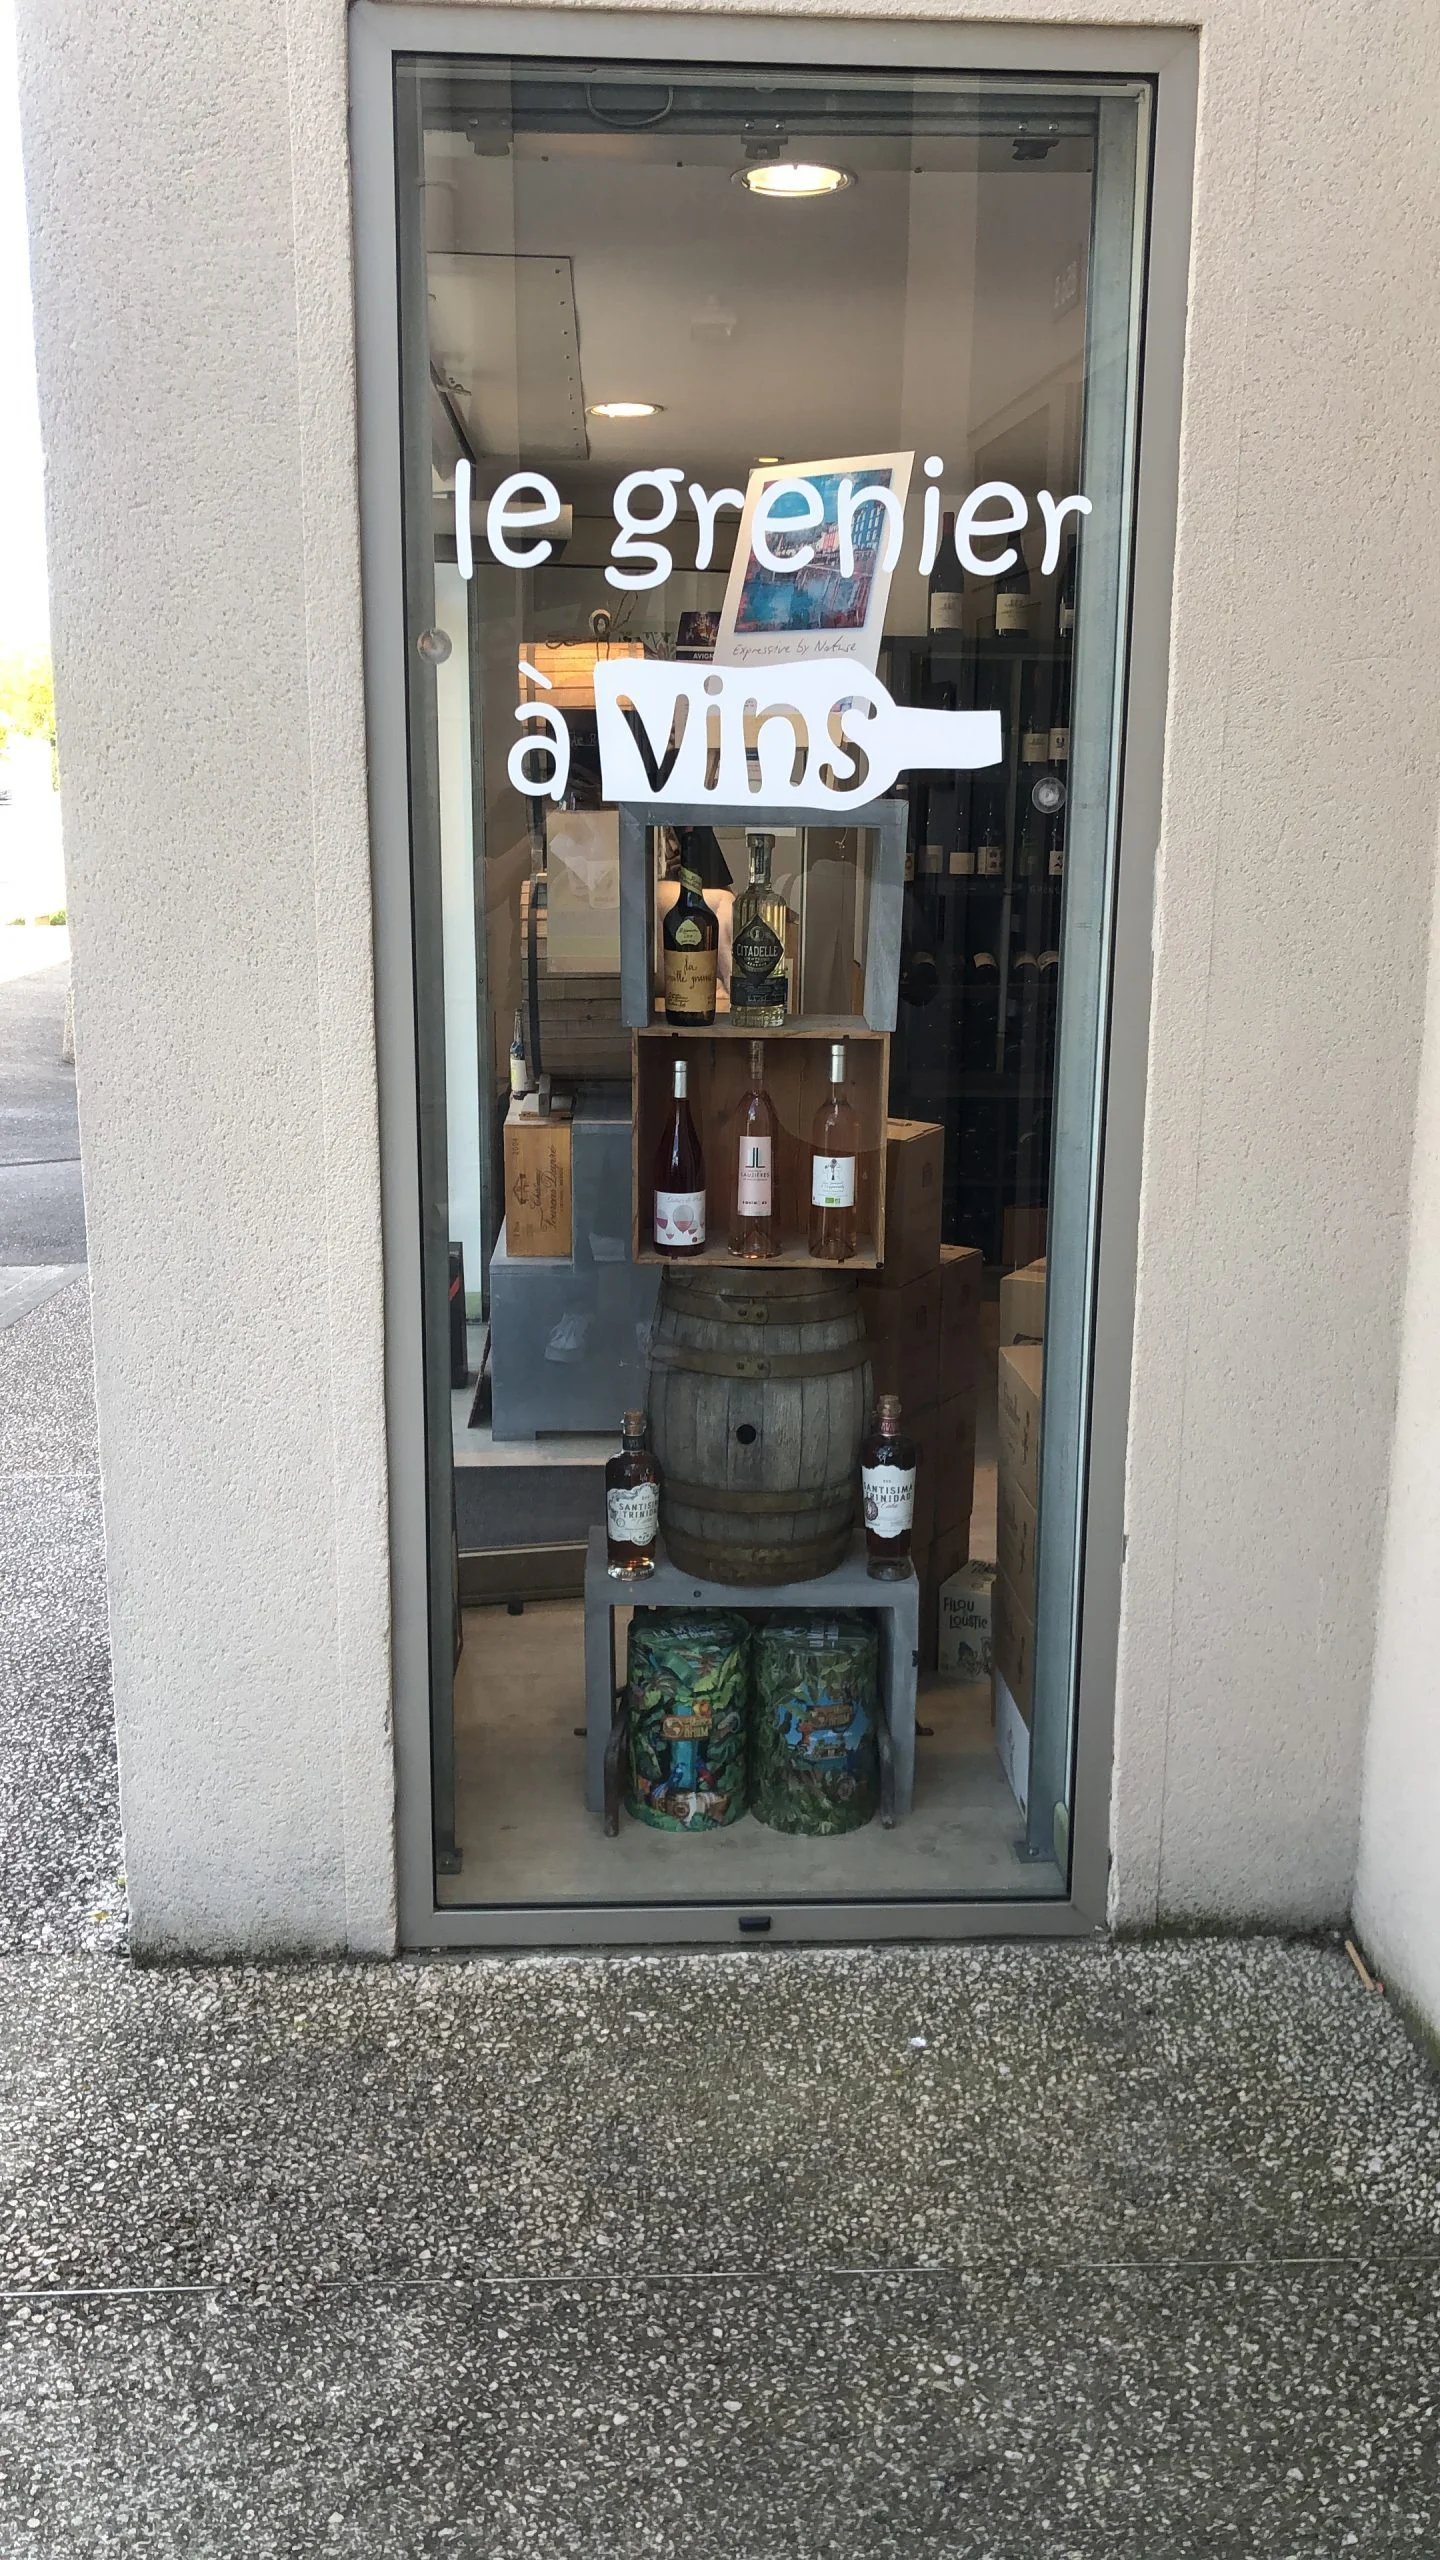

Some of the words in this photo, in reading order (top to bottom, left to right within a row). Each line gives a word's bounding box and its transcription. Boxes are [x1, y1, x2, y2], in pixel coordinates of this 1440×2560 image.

[454, 457, 562, 580] le
[604, 455, 1093, 591] grenier
[732, 643, 791, 662] Expressive
[797, 638, 808, 656] by
[814, 635, 857, 653] Nature
[507, 662, 570, 802] à
[616, 674, 878, 794] vins
[736, 944, 778, 957] CITADELLE
[863, 1481, 913, 1494] SANTISIMA
